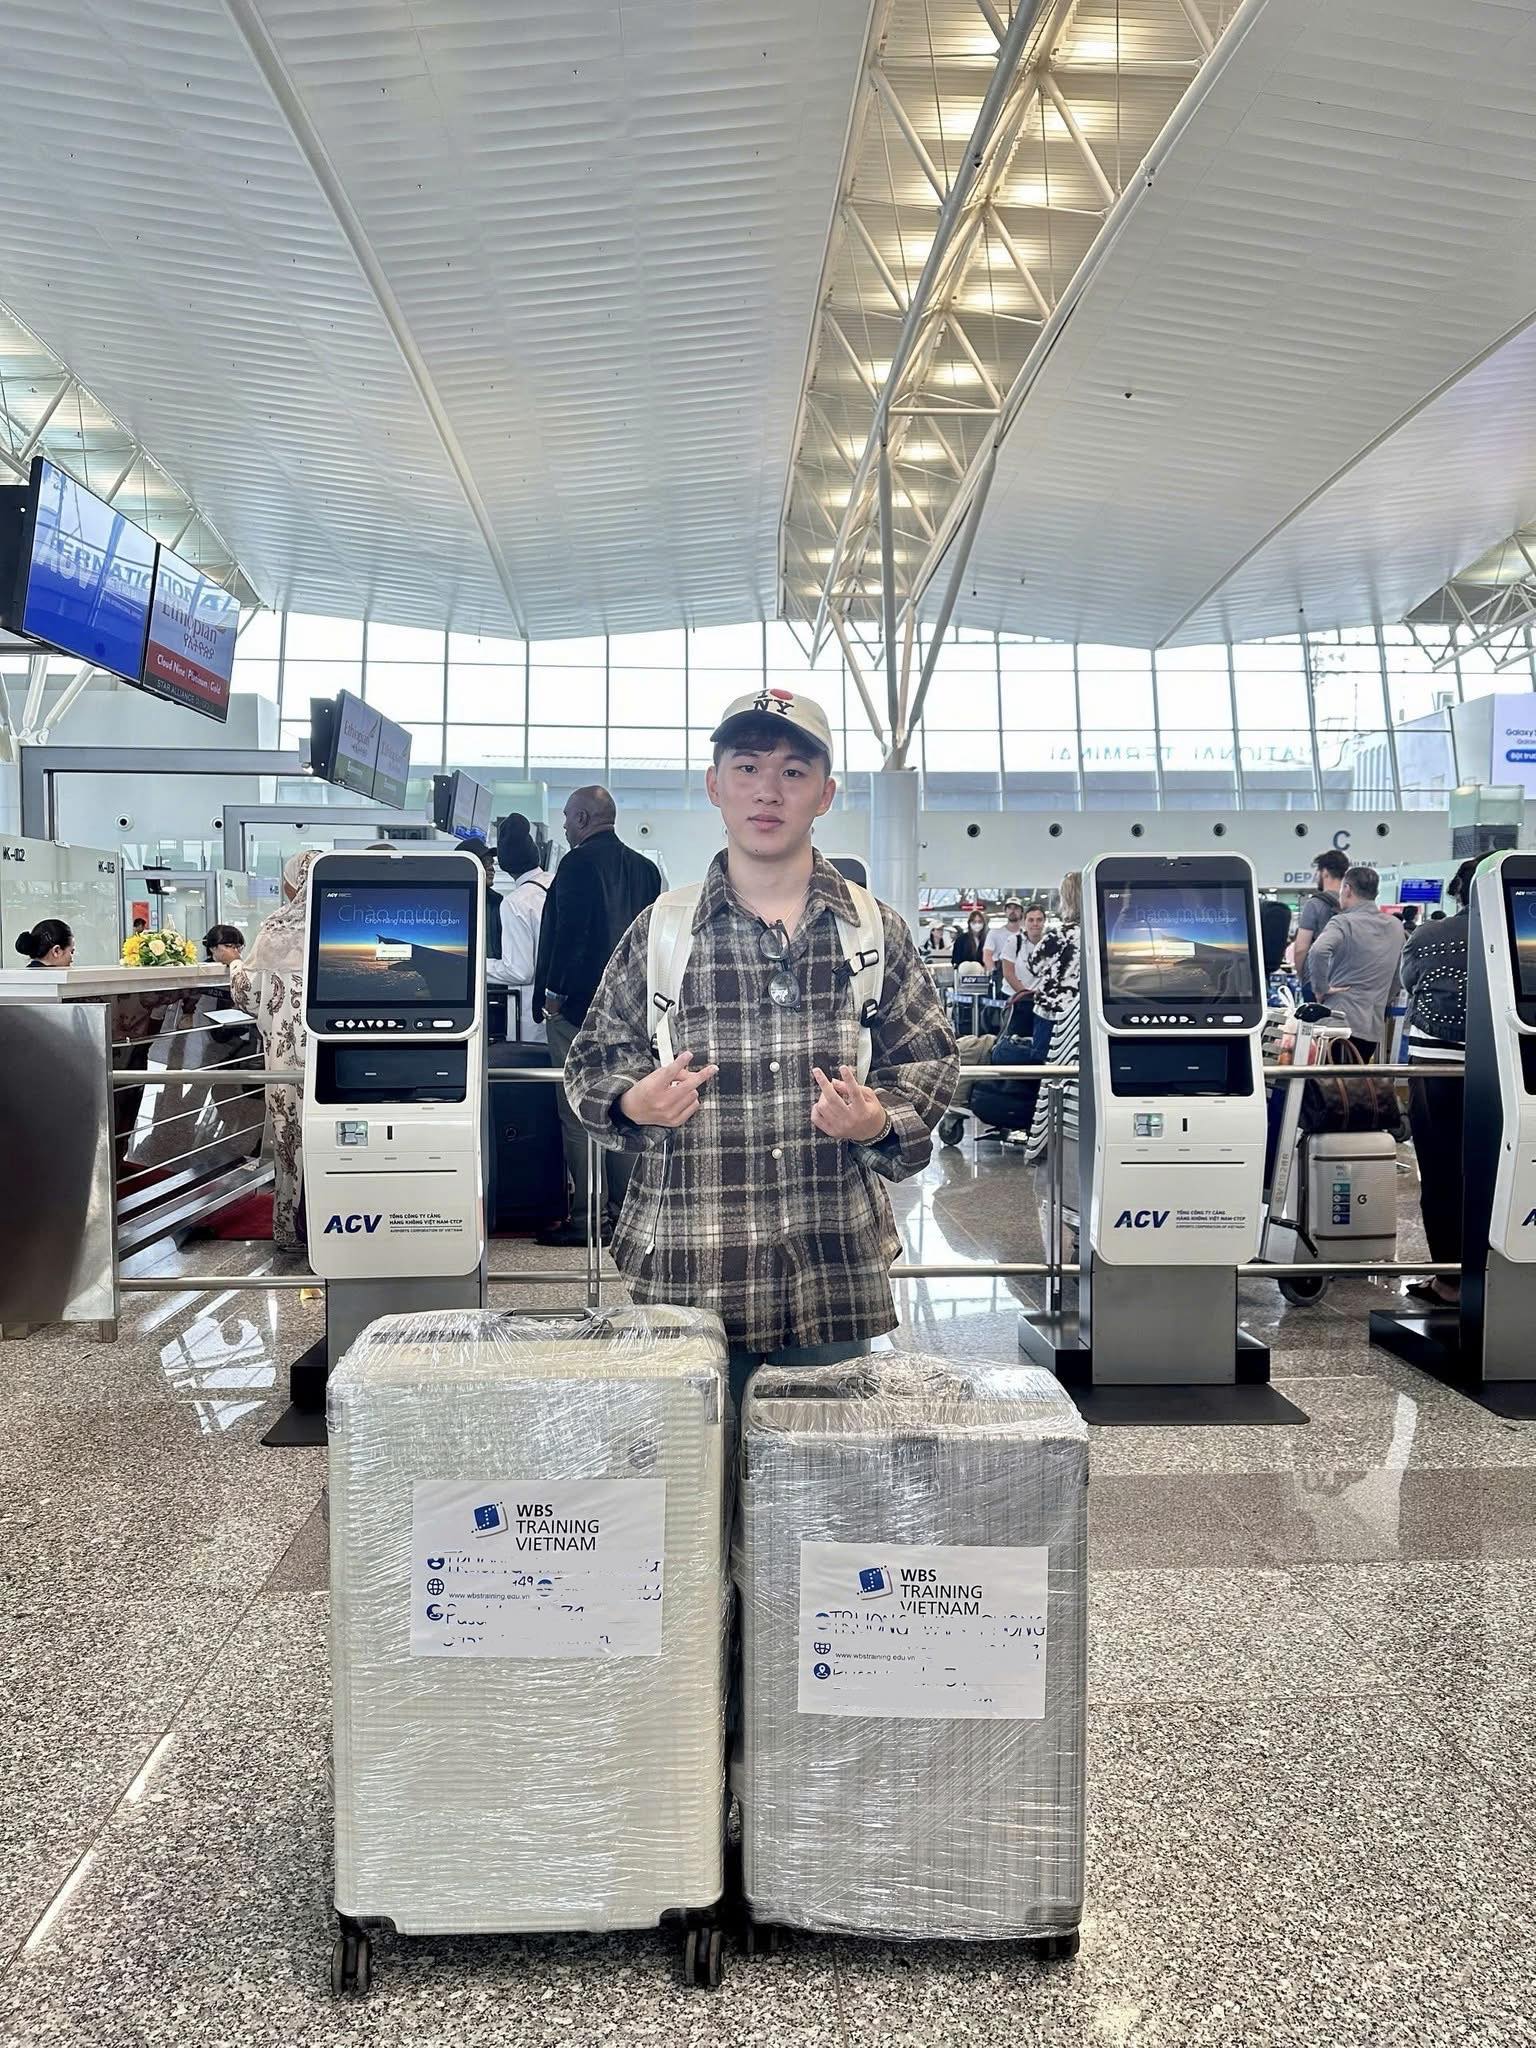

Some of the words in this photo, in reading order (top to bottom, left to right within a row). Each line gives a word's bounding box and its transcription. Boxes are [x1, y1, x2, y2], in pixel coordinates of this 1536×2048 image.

[157, 654, 172, 670] Cloud
[173, 662, 185, 678] Nine
[157, 680, 171, 692] STAR
[757, 689, 769, 698] I
[753, 699, 794, 715] NY
[1506, 728, 1533, 737] Galaxy
[1333, 830, 1351, 851] C
[324, 1214, 383, 1234] ACV
[1114, 1210, 1170, 1228] ACV
[516, 1504, 554, 1517] WBS
[516, 1519, 600, 1534] TRAINING
[516, 1536, 596, 1552] VIETNAM
[900, 1568, 937, 1582] WBS
[449, 1592, 530, 1600] wwwwbstrainingeduvn
[900, 1584, 983, 1599] TRAINING
[900, 1601, 979, 1616] VIETNAM
[835, 1653, 916, 1661] wwwwbstrainingeduvn
